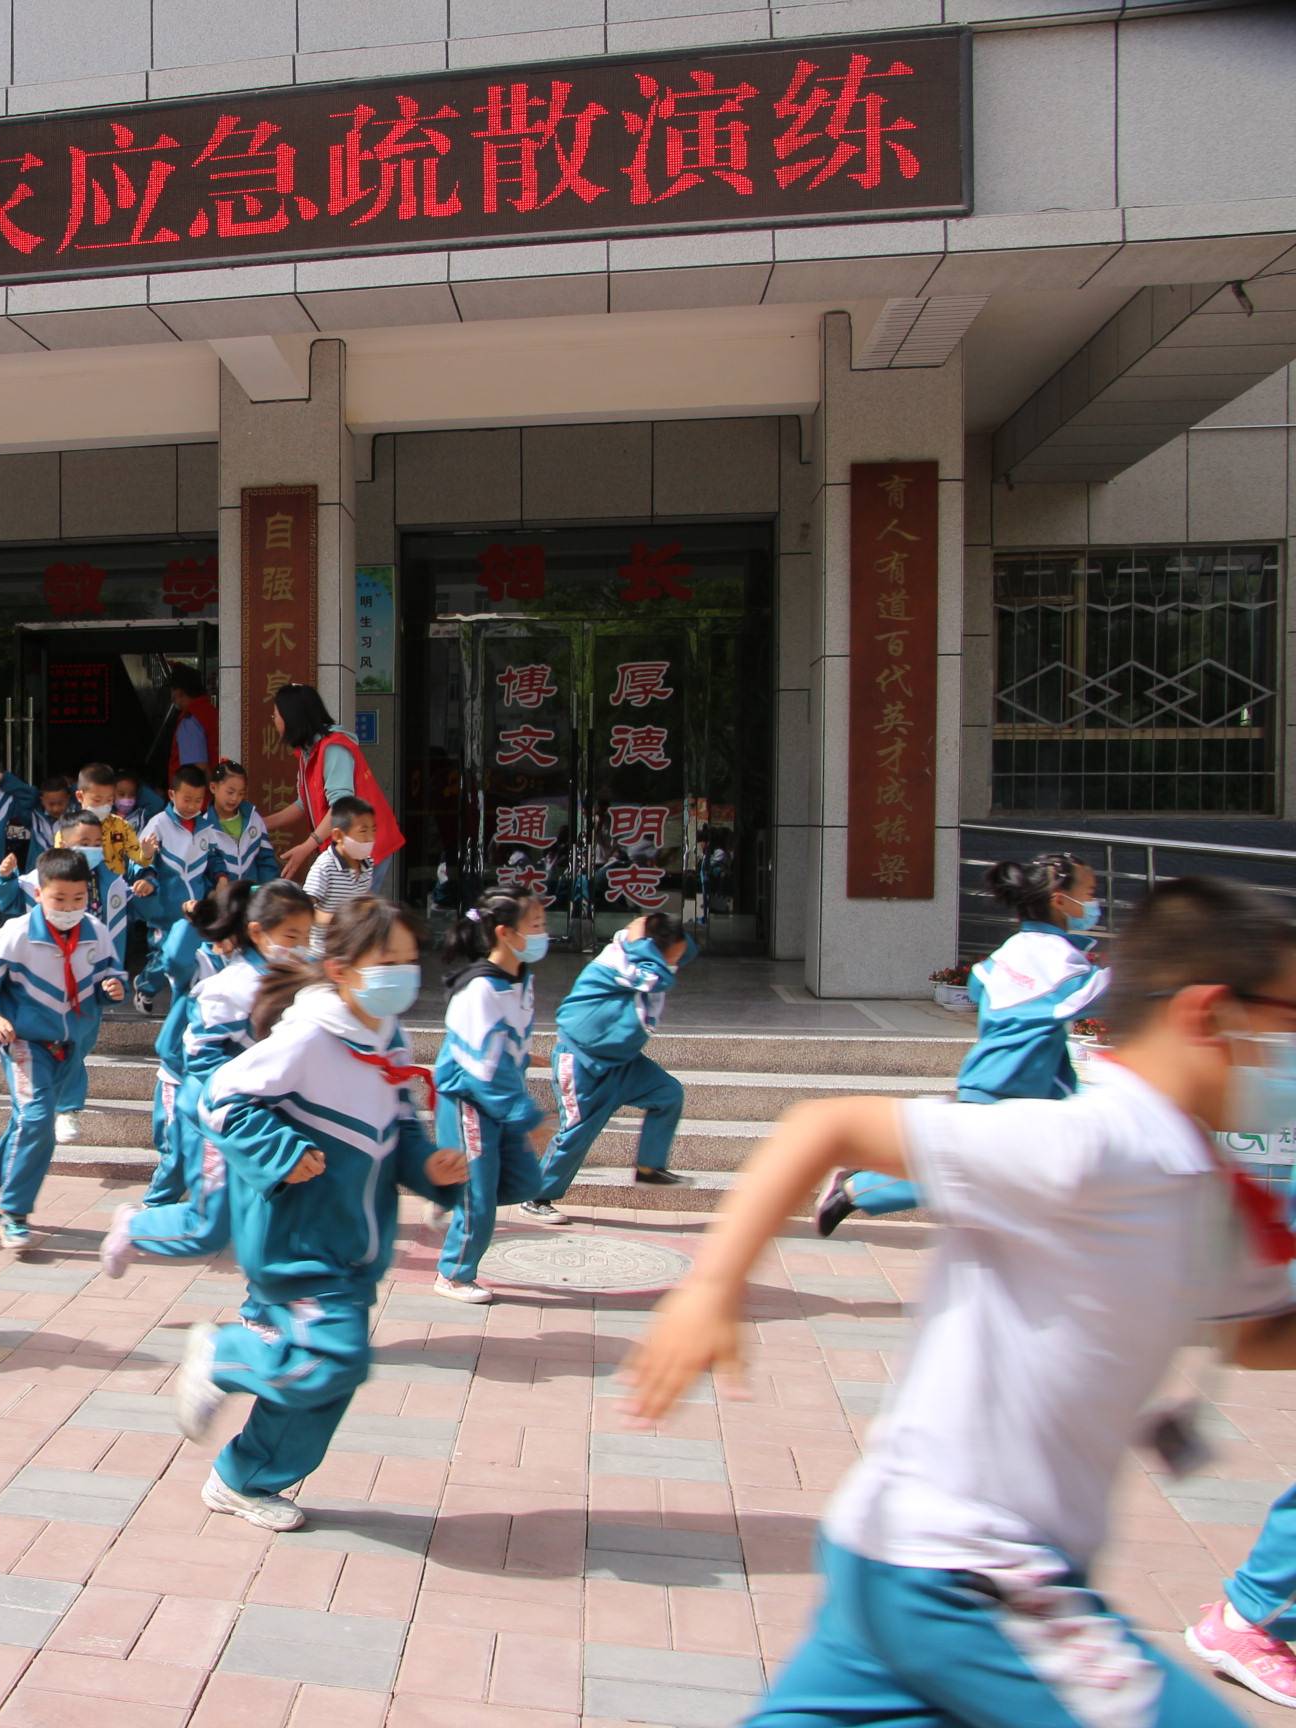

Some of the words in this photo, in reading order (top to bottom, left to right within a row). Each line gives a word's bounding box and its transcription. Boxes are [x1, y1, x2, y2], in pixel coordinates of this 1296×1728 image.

[495, 662, 558, 908] 博文通达
[606, 660, 674, 908] 厚德明志
